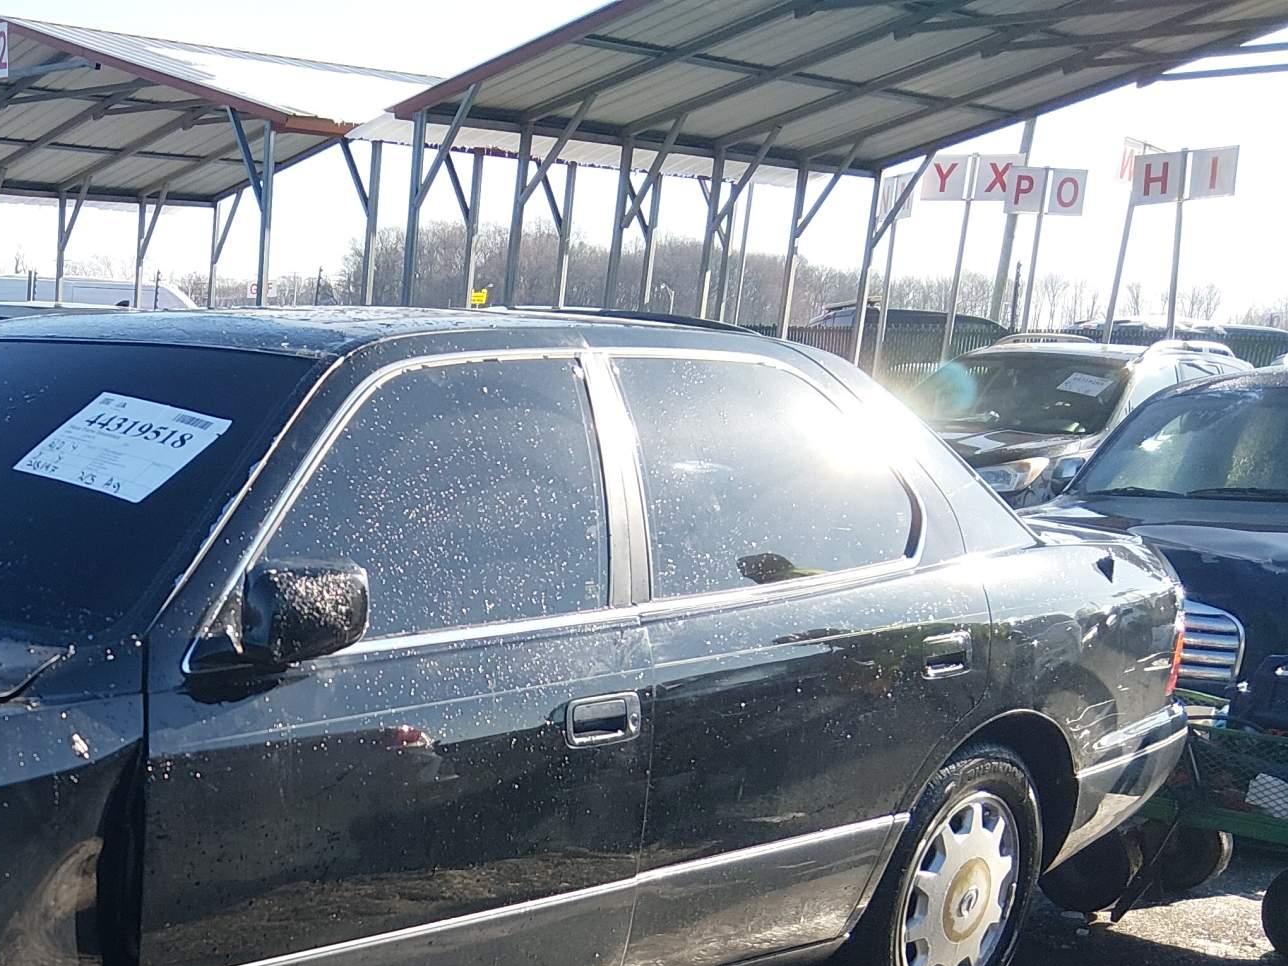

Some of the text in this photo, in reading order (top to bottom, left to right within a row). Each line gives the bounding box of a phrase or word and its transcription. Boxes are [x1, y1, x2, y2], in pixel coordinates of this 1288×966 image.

[933, 163, 959, 192] Y
[984, 163, 1013, 193] X
[1143, 162, 1169, 196] H
[1208, 156, 1219, 190] I
[1013, 175, 1034, 205] P
[1056, 177, 1079, 208] O
[85, 413, 193, 448] 44319518
